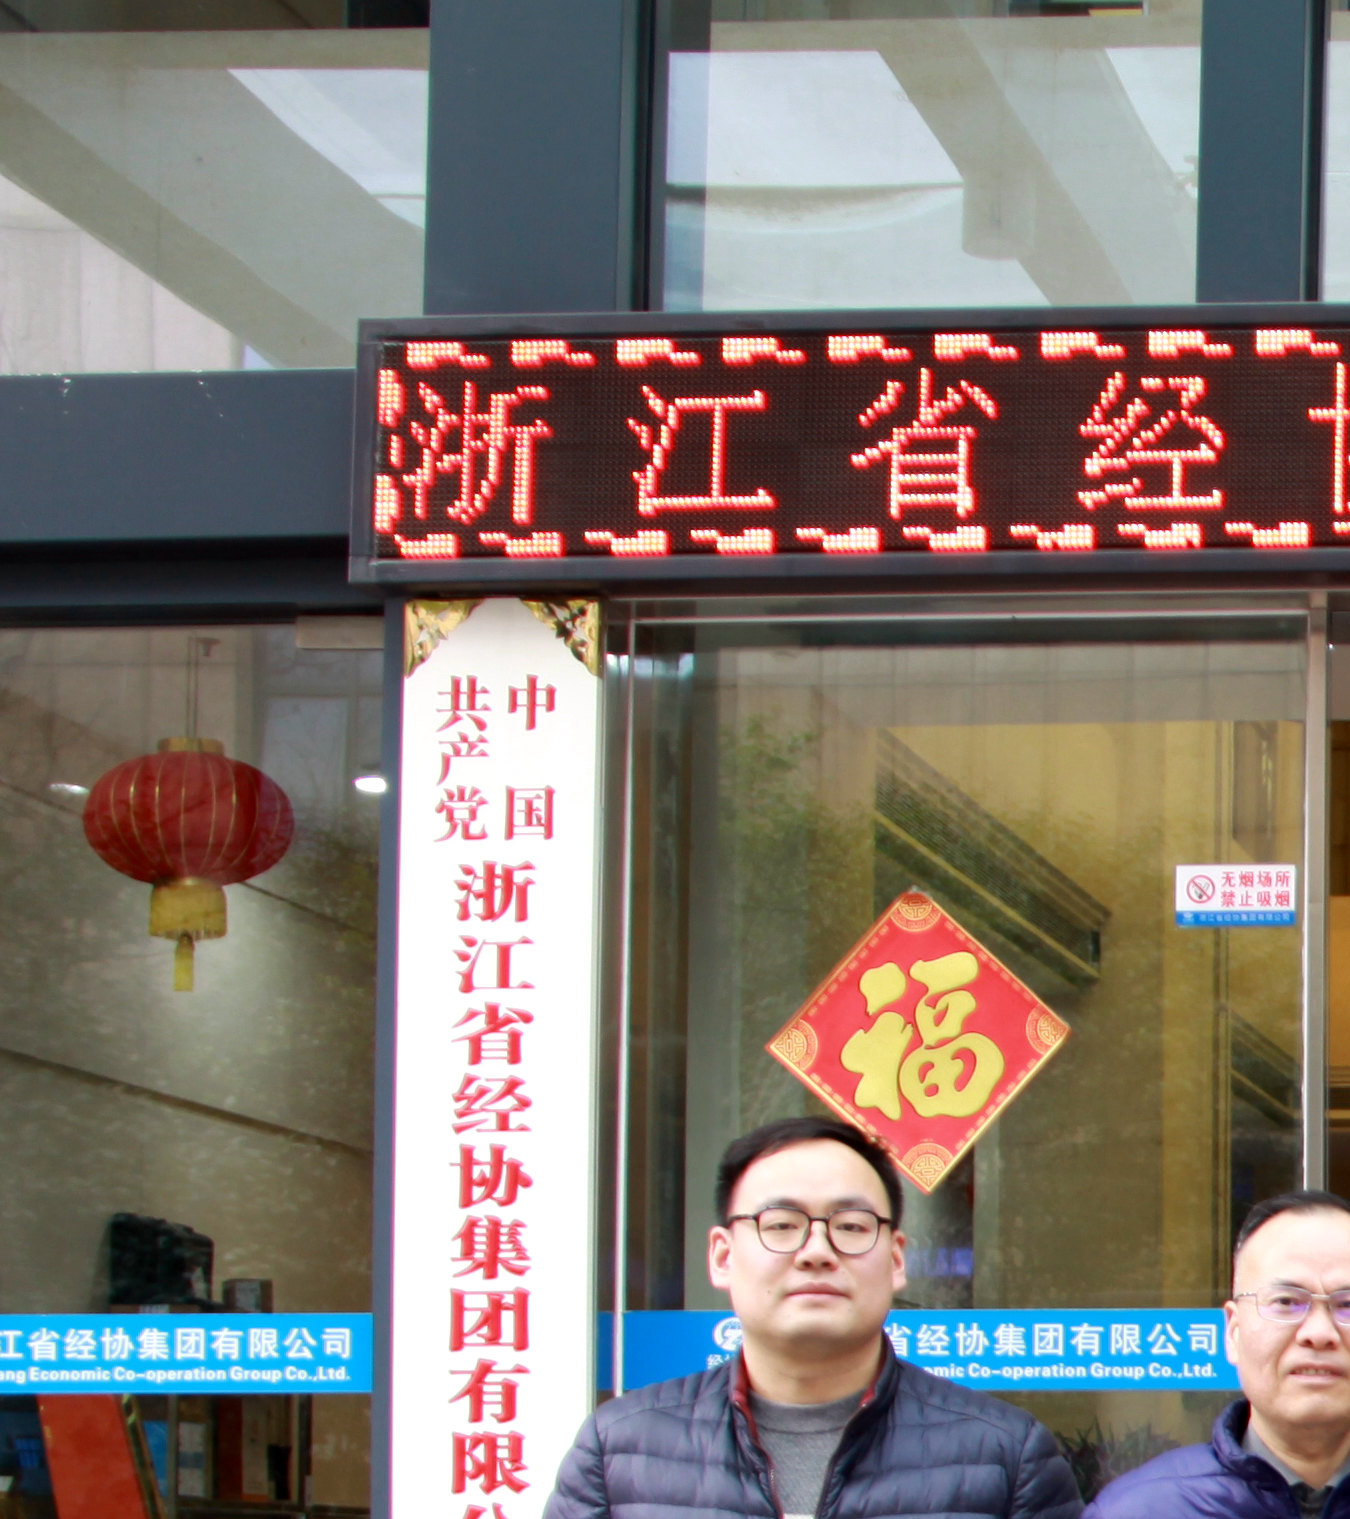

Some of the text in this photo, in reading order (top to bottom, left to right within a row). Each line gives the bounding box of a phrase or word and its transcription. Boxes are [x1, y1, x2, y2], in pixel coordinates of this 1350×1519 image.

[435, 674, 491, 843] 共产党
[505, 674, 557, 841] 中国
[1221, 871, 1291, 888] 无烟场所
[1221, 890, 1291, 907] 禁止吸烟
[840, 951, 1005, 1121] 福
[884, 1322, 1218, 1357] 省经协集团有限公司
[30, 1366, 111, 1382] Economic
[230, 1366, 283, 1384] Group
[1091, 1362, 1145, 1380] Group
